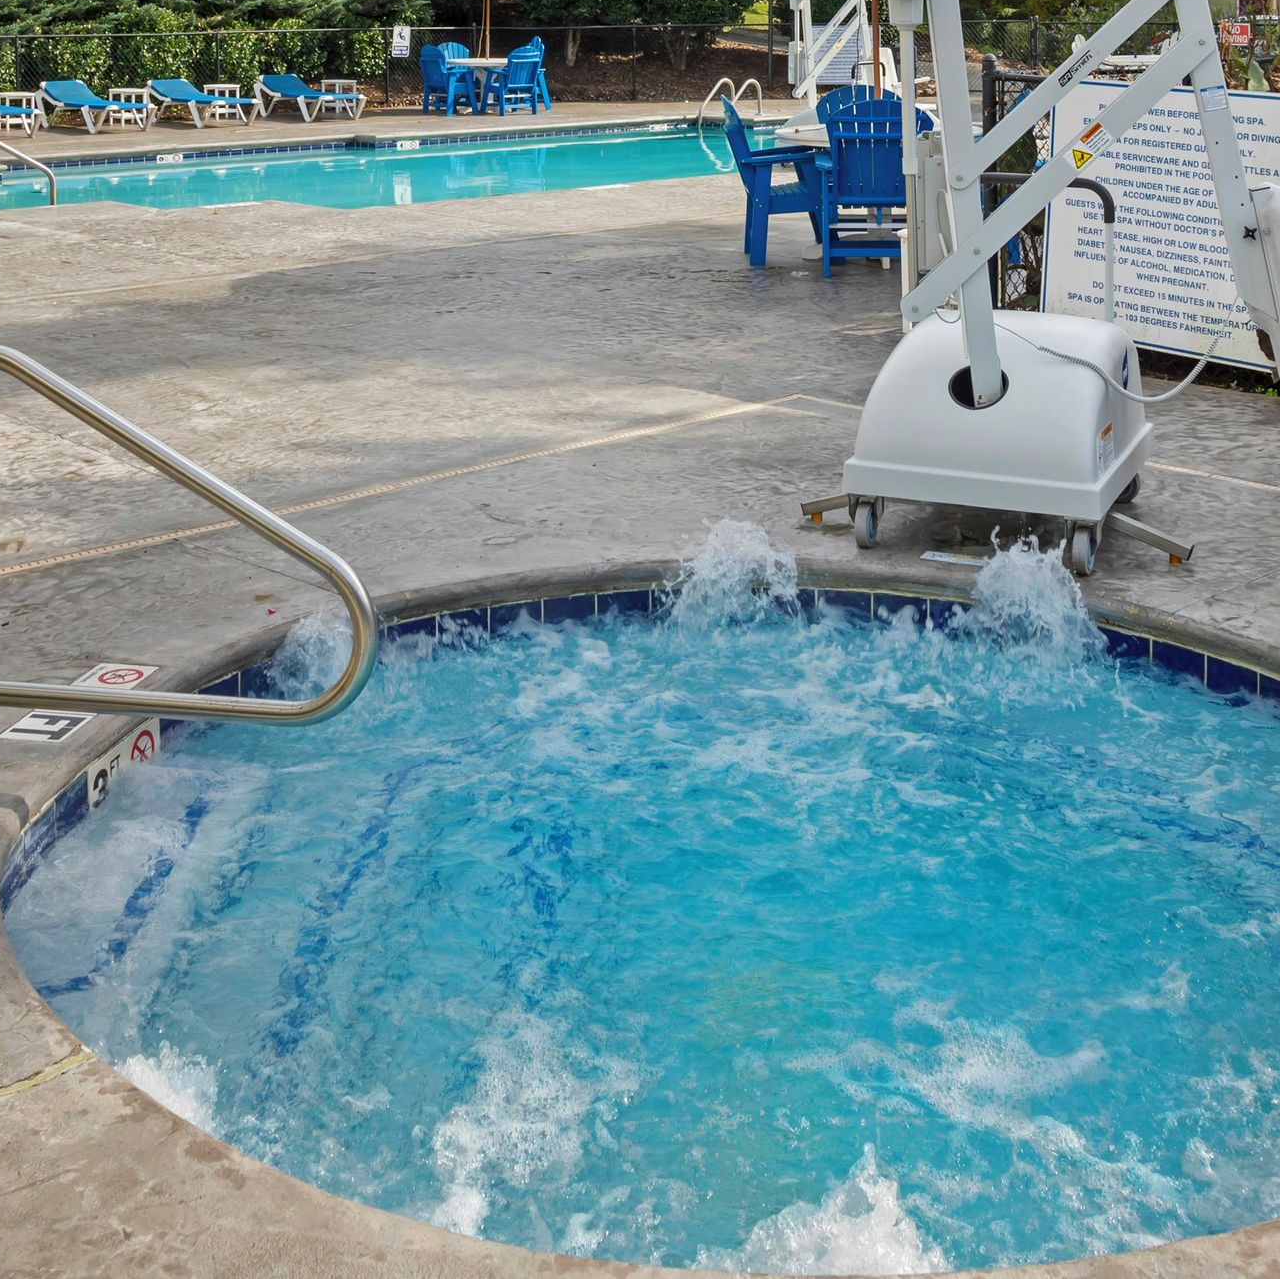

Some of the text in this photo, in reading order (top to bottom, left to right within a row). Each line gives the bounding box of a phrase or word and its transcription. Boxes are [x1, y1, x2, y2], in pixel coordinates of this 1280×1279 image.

[1231, 34, 1248, 43] VING
[1071, 54, 1093, 75] Smith
[1167, 109, 1200, 120] BEFORE
[1246, 116, 1267, 127] SPA.
[1132, 122, 1148, 131] EPS
[1149, 123, 1172, 133] ONLY
[1183, 127, 1195, 136] NO
[1236, 132, 1249, 141] OR
[1123, 137, 1141, 147] FOR
[1141, 138, 1192, 151] REGISTERED
[1114, 163, 1162, 175] PROHIBITED
[1164, 168, 1172, 176] IN
[1175, 169, 1191, 178] THE
[1122, 152, 1180, 166] SERVICEWARE
[1182, 159, 1200, 169] AND
[1244, 166, 1271, 176] TTLES
[1095, 176, 1214, 197] CHILDREN UNDER THE AGE OF
[1122, 190, 1219, 209] ACCOMPANIED BY ADUL
[1065, 198, 1096, 209] GUESTS
[1120, 205, 1134, 214] THE
[1136, 207, 1185, 221] FOLLOWING
[1186, 214, 1224, 226] CONDITI
[1083, 211, 1098, 220] USE
[1117, 216, 1133, 225] SPA
[1135, 218, 1172, 231] WITHOUT
[1173, 224, 1217, 237] DOCTOR'S
[1077, 226, 1229, 255] HEART SEASE, HIGH OR LOW BLOOD
[1073, 250, 1116, 263] INFLUENE
[1118, 257, 1129, 265] OF
[1130, 259, 1171, 273] ALCOHOL,
[1173, 265, 1228, 281] MEDICATION,
[1120, 244, 1155, 258] NAUSEA,
[1156, 250, 1201, 264] DIZZINESS,
[1203, 257, 1233, 268] FAINTI
[1136, 272, 1210, 292] WHEN PREGNANT.
[1092, 281, 1104, 290] DO
[1123, 286, 1155, 298] EXCEED
[1158, 292, 1166, 300] 15
[1167, 293, 1205, 306] MINUTES
[1206, 299, 1215, 308] IN
[1216, 301, 1233, 311] THE
[1235, 304, 1249, 314] SP
[1067, 292, 1083, 302] SPA
[1084, 295, 1092, 303] IS
[1140, 304, 1180, 319] BETWEEN
[1181, 311, 1198, 321] THE
[1199, 315, 1261, 332] TEMPERATUR
[1125, 313, 1138, 323] 103
[1139, 315, 1178, 329] DEGREES
[1179, 322, 1236, 341] FAHRENHEIT.
[9, 714, 86, 741] FT
[109, 754, 121, 778] FT
